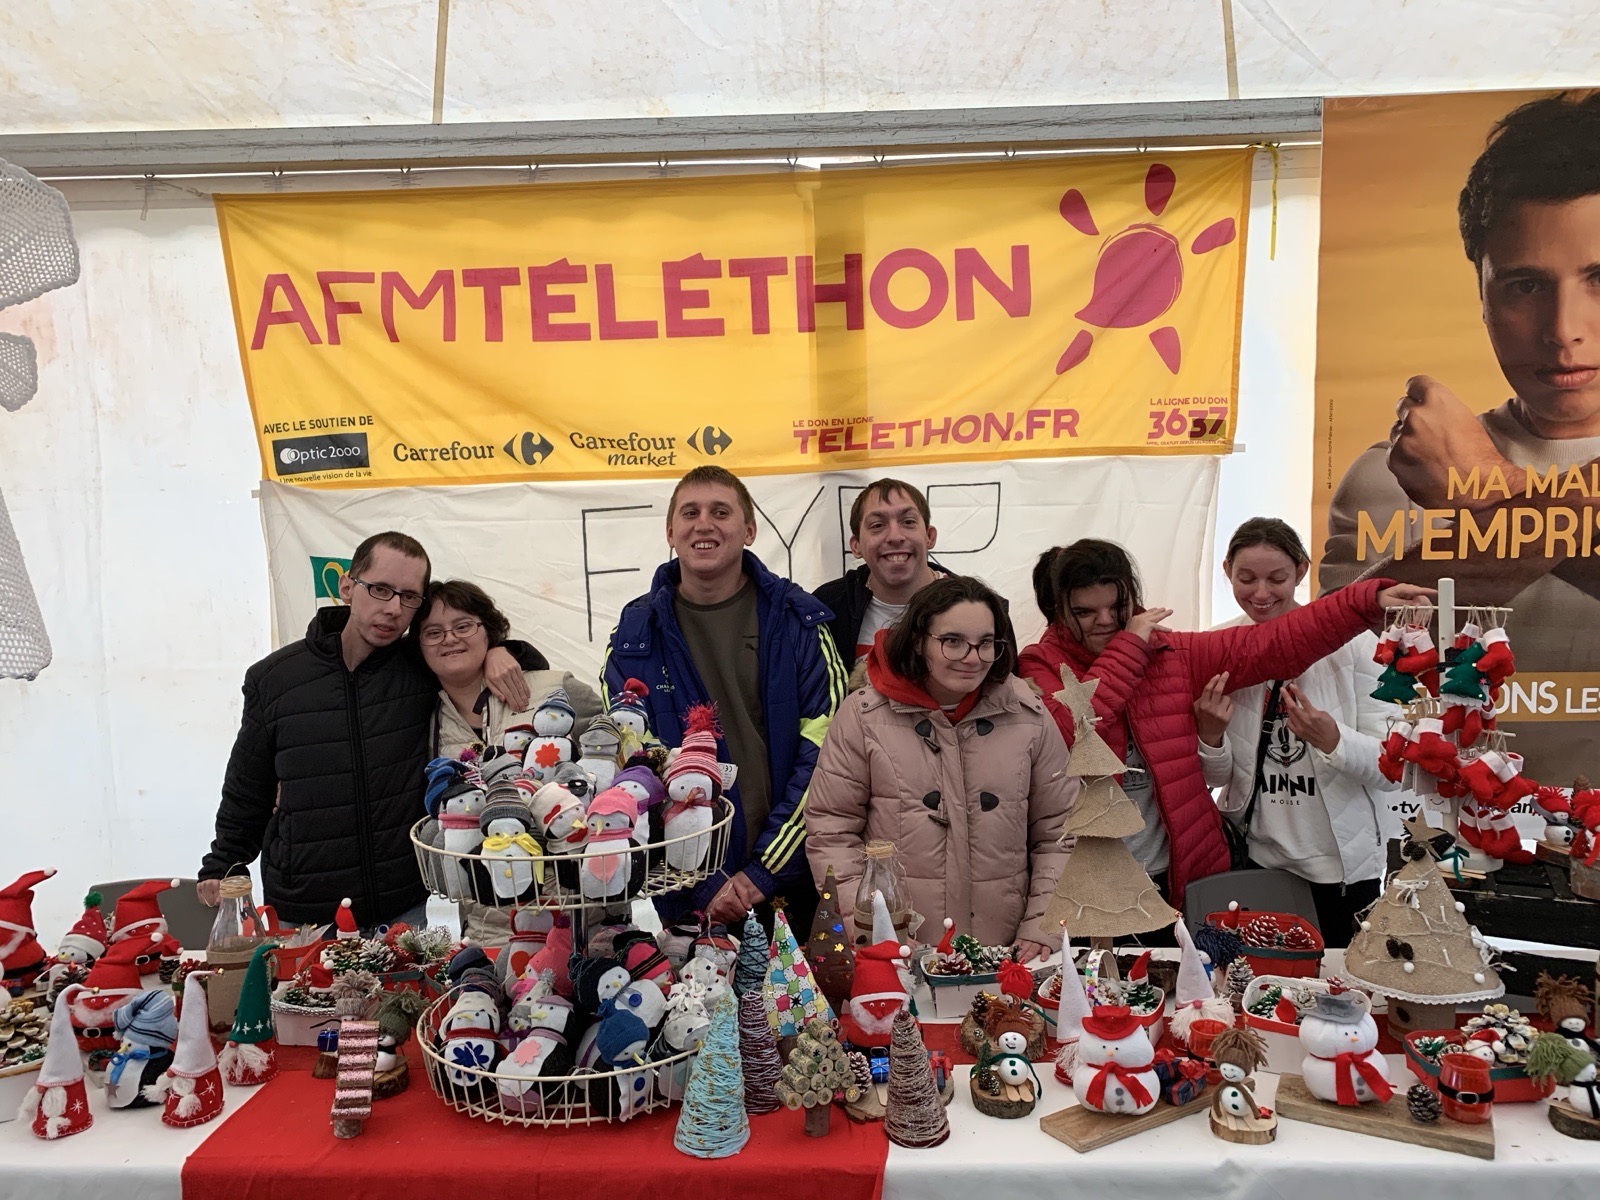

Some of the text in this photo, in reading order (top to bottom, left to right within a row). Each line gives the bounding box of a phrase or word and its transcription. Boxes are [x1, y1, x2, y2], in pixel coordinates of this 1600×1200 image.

[1149, 396, 1228, 406] LA LIGNE DU DON
[263, 415, 374, 435] AVEC LE SOUTIEN DE
[792, 416, 874, 428] LE DON EN LIGNE
[793, 408, 1080, 454] TELETHON.FR
[1147, 406, 1228, 440] 3637
[393, 441, 495, 463] Carrefour
[568, 431, 676, 453] Carrefour
[285, 446, 360, 464] Optic 2000
[607, 450, 678, 468] market
[322, 472, 343, 480] vision
[1446, 465, 1512, 500] MA
[1356, 506, 1600, 561] M'EMPRI
[1565, 687, 1600, 714] LE
